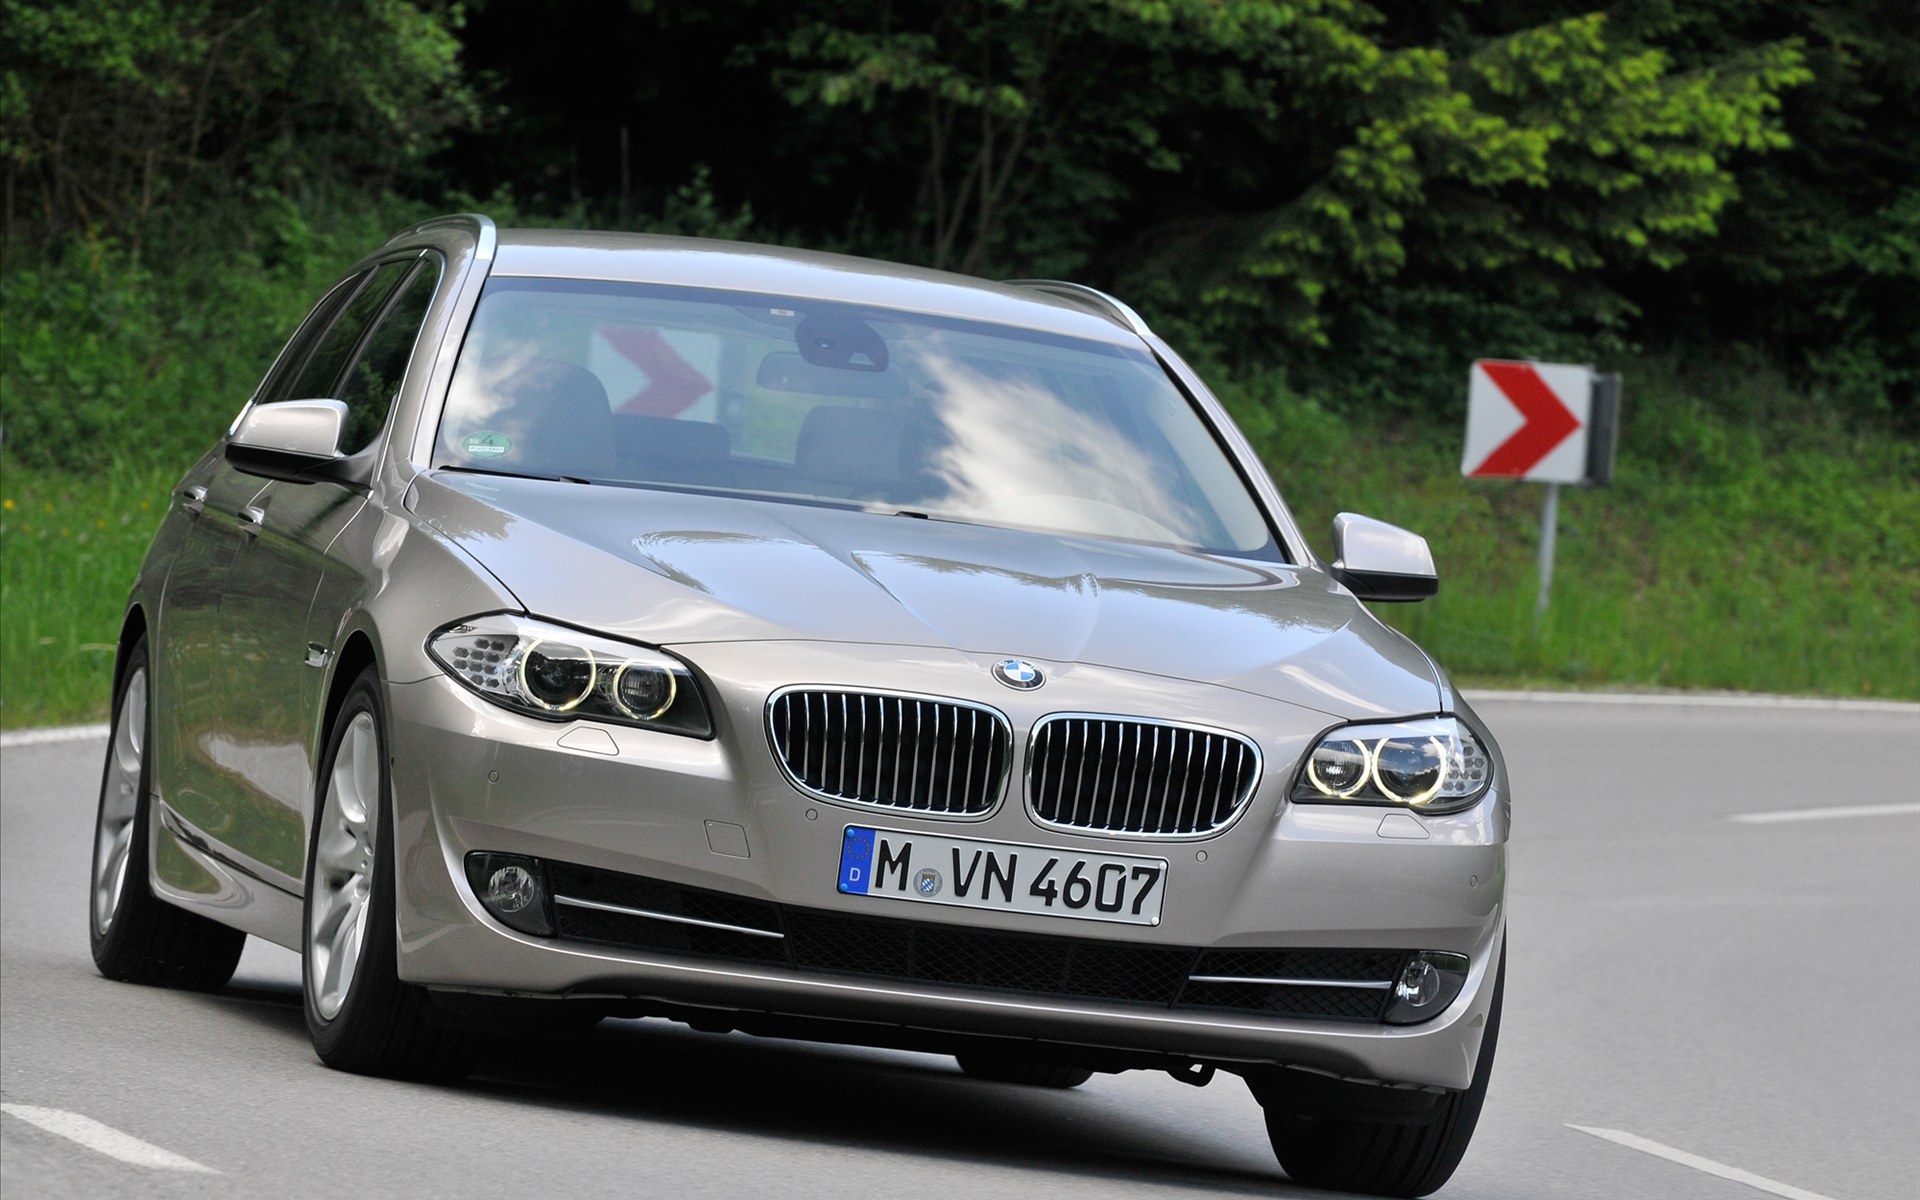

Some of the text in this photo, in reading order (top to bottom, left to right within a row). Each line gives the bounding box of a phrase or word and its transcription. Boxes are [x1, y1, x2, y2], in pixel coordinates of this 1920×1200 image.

[849, 867, 861, 882] D
[875, 839, 1161, 915] M VN 4607
